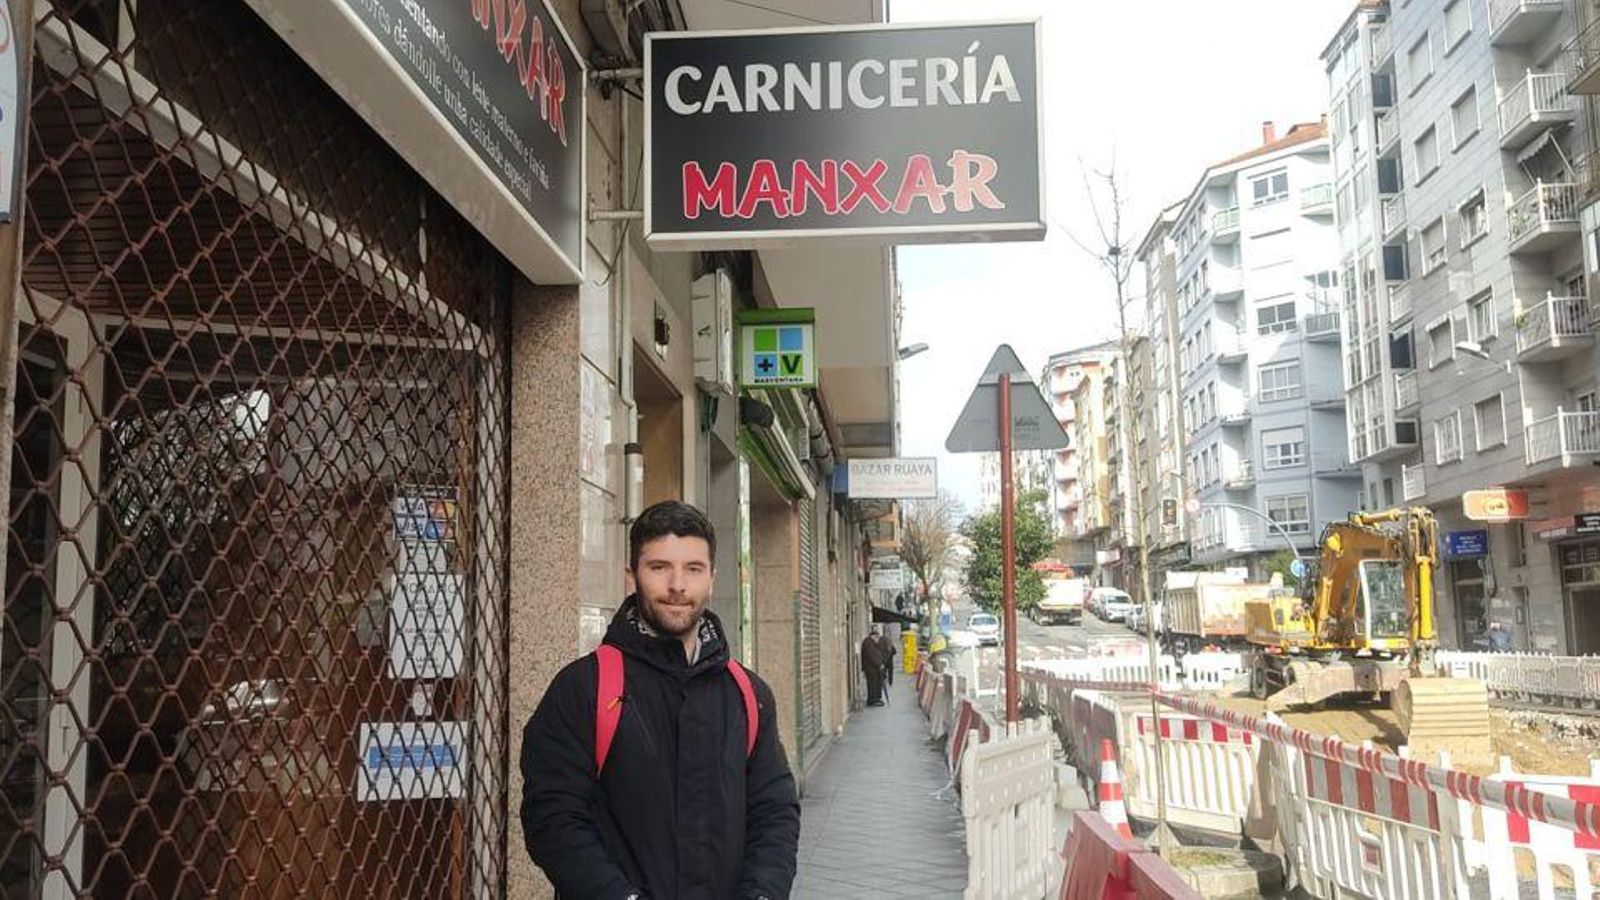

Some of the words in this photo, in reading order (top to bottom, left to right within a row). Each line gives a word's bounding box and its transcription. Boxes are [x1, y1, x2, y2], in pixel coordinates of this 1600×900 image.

[394, 18, 442, 94] dándolle
[444, 83, 467, 128] unha
[401, 0, 450, 62] entando
[453, 54, 470, 90] con
[664, 40, 1022, 115] CARNICERÍA
[682, 149, 1005, 219] MANXAR
[852, 463, 891, 476] BAZAR
